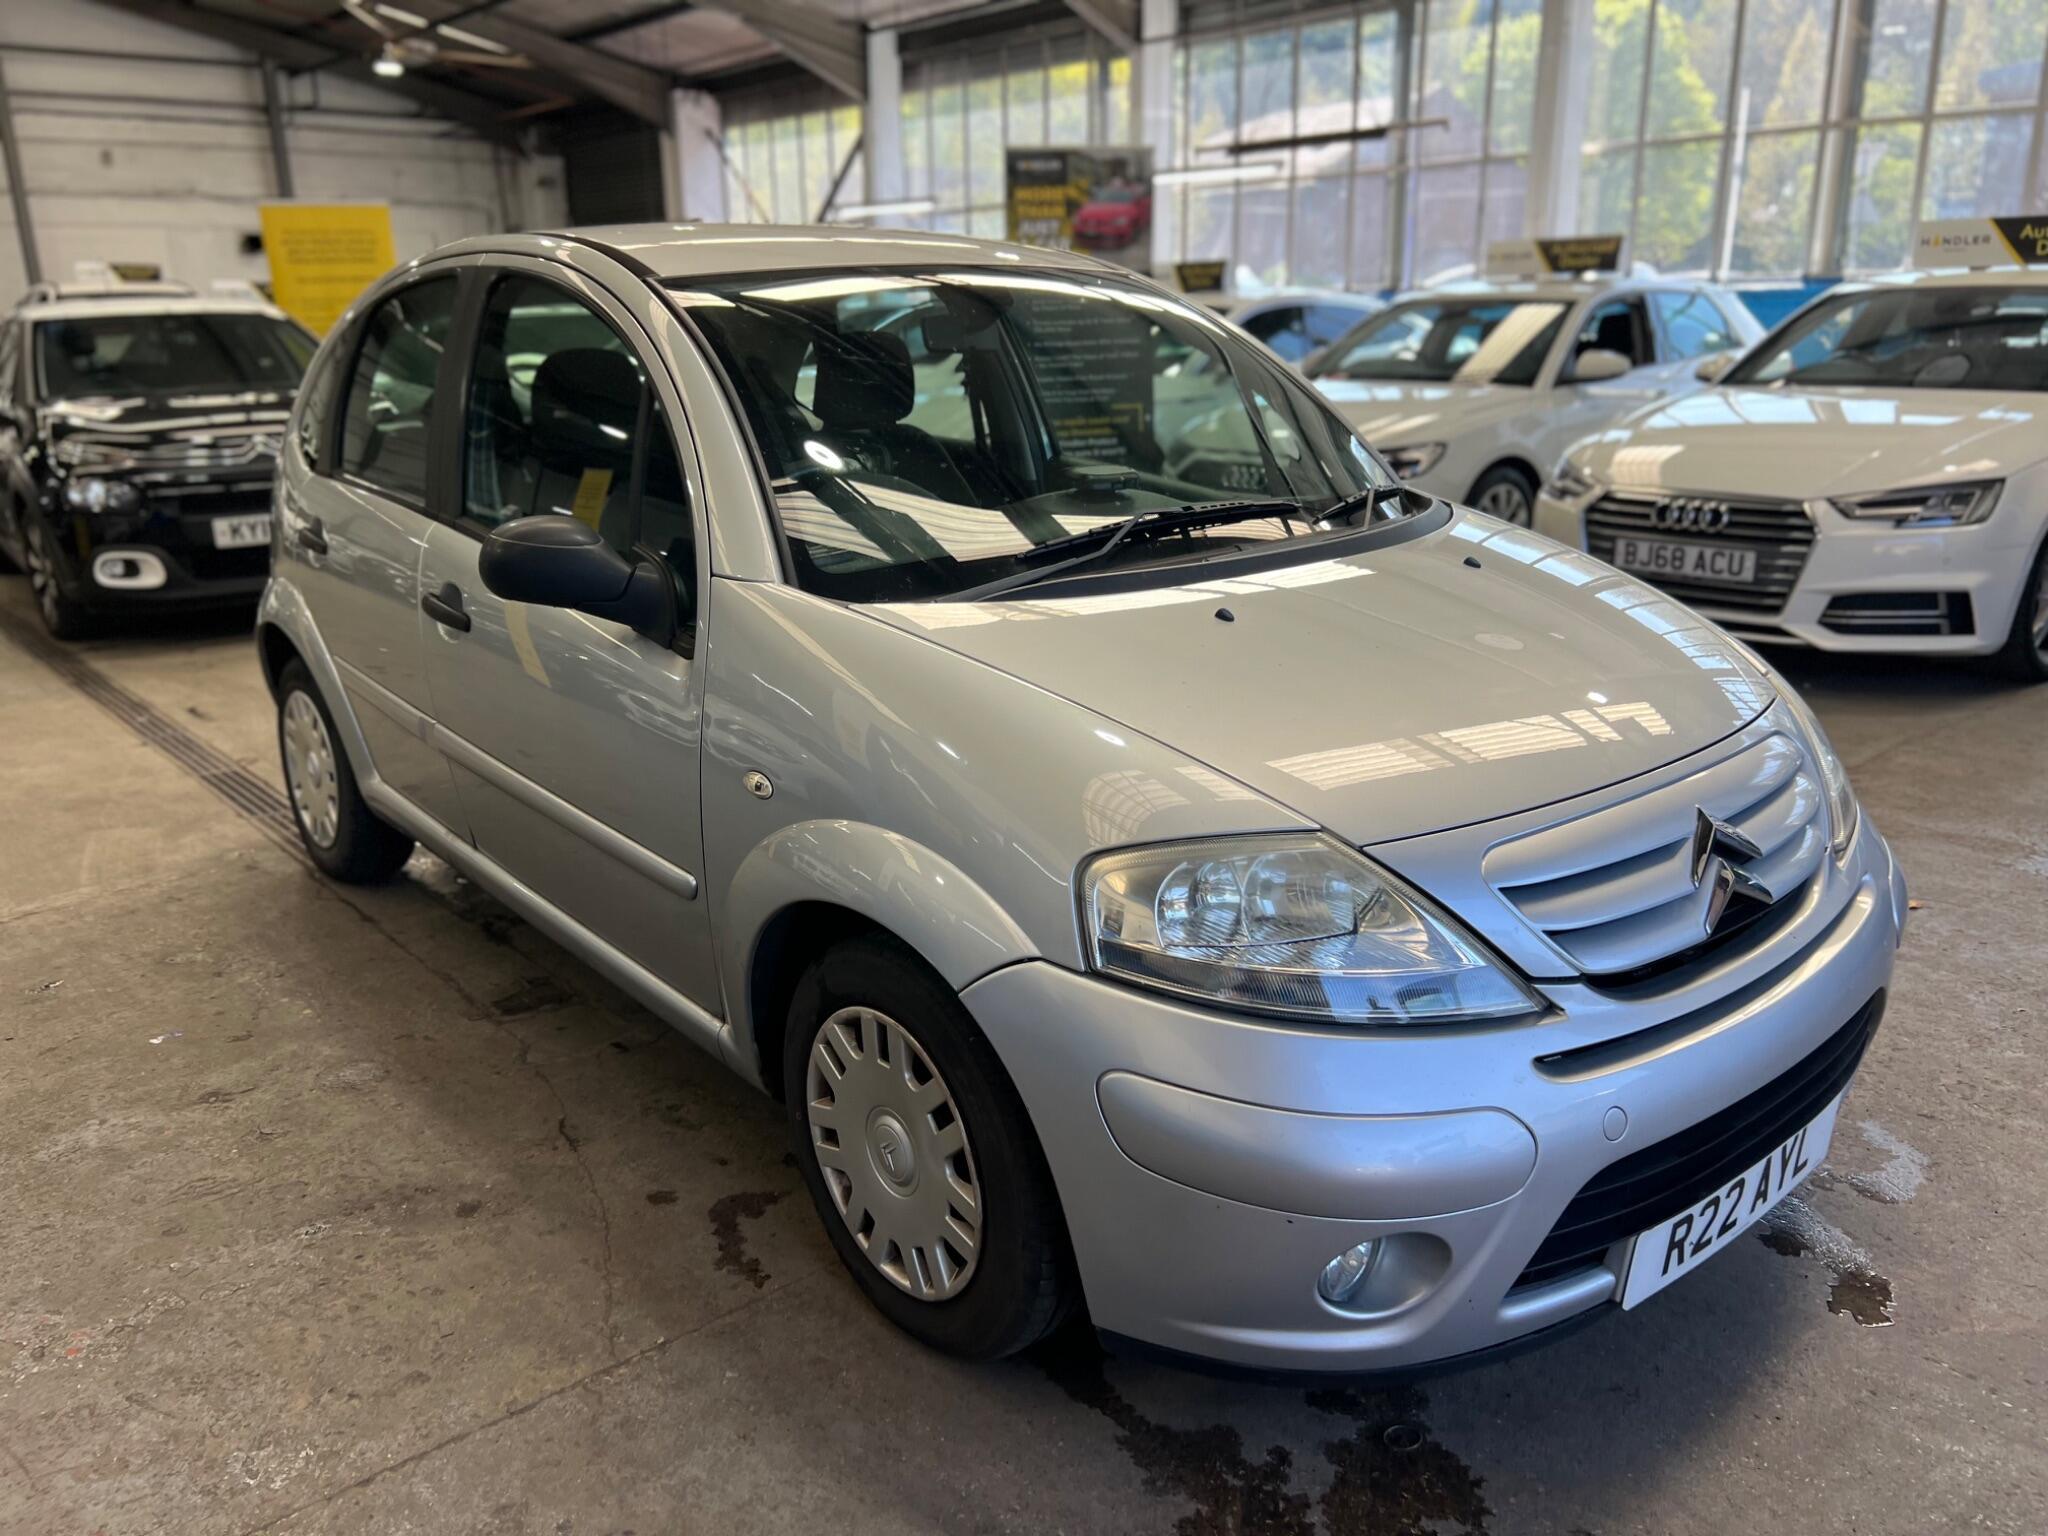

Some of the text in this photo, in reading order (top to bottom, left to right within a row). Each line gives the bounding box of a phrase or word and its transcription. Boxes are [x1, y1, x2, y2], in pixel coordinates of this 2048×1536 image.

[2019, 223, 2048, 240] Au
[1623, 542, 1746, 577] BJ68 ACU
[1661, 1126, 1809, 1277] R22 AYL
